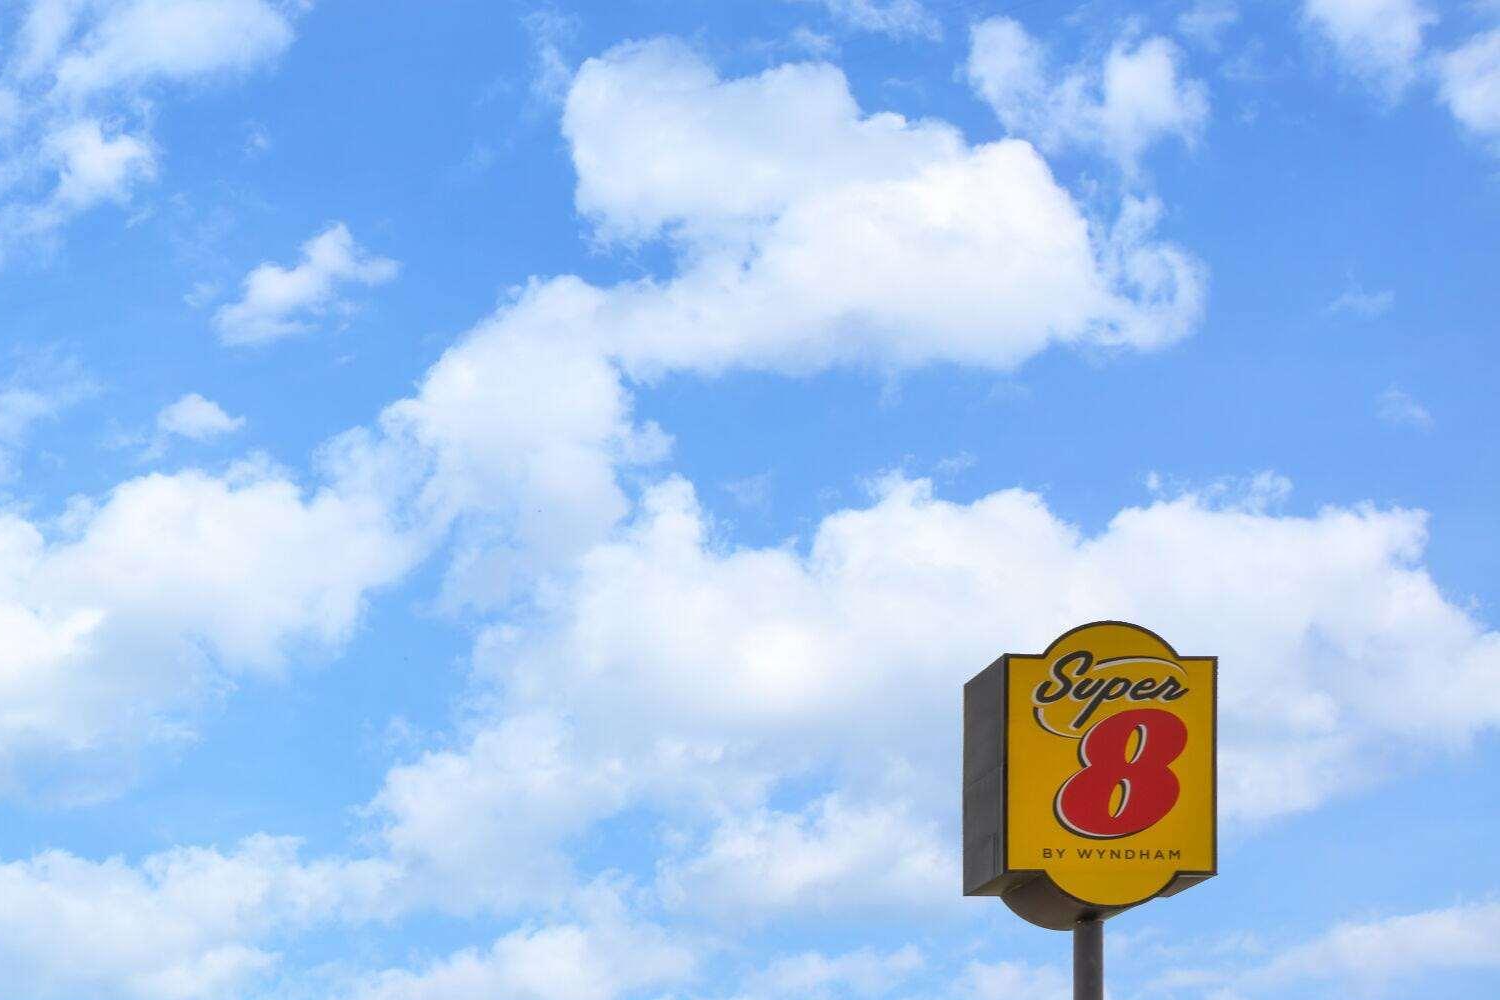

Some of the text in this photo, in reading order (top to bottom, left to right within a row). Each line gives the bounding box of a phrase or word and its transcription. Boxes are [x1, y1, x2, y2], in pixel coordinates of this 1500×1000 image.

[1033, 650, 1190, 730] Super
[1052, 708, 1188, 841] 8
[1042, 848, 1181, 861] BY WYNDHAM
